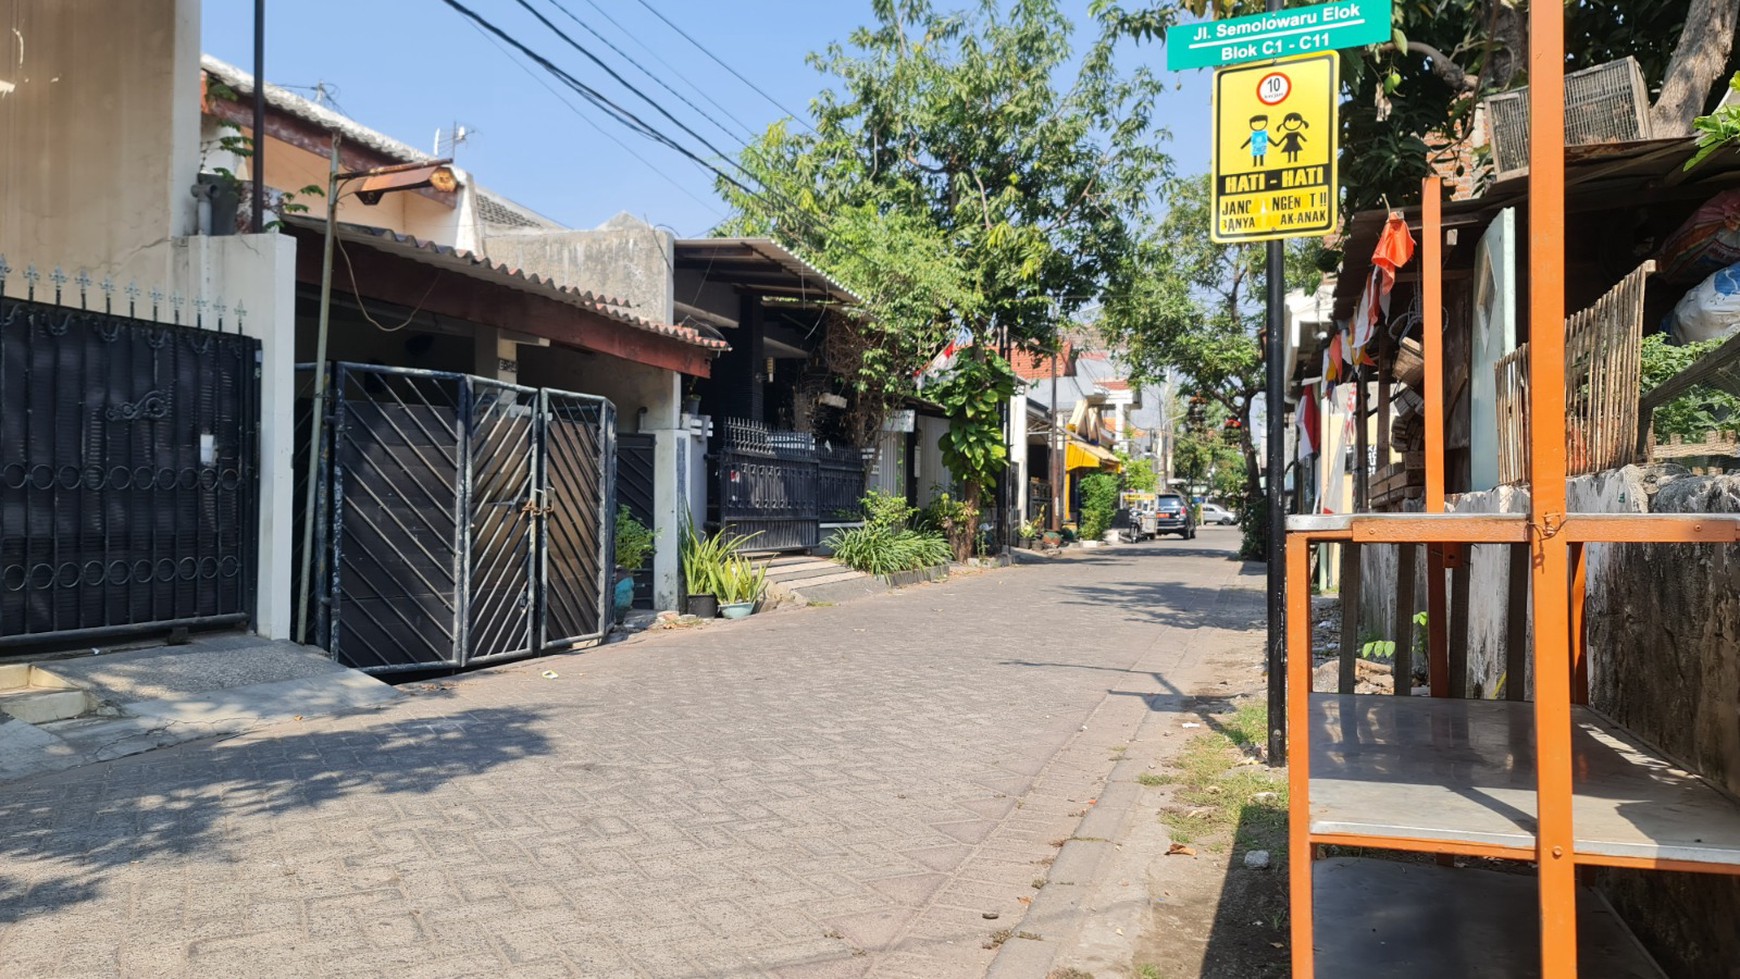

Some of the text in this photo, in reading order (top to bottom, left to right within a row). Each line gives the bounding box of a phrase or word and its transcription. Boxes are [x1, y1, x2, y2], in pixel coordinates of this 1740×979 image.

[1193, 4, 1360, 41] Jl. Semolowaru Elok
[1221, 45, 1257, 60] Blok
[1262, 40, 1282, 54] C1
[1300, 33, 1329, 49] C11
[1267, 77, 1281, 93] 10
[1225, 173, 1265, 194] HATI
[1282, 166, 1323, 188] HATI
